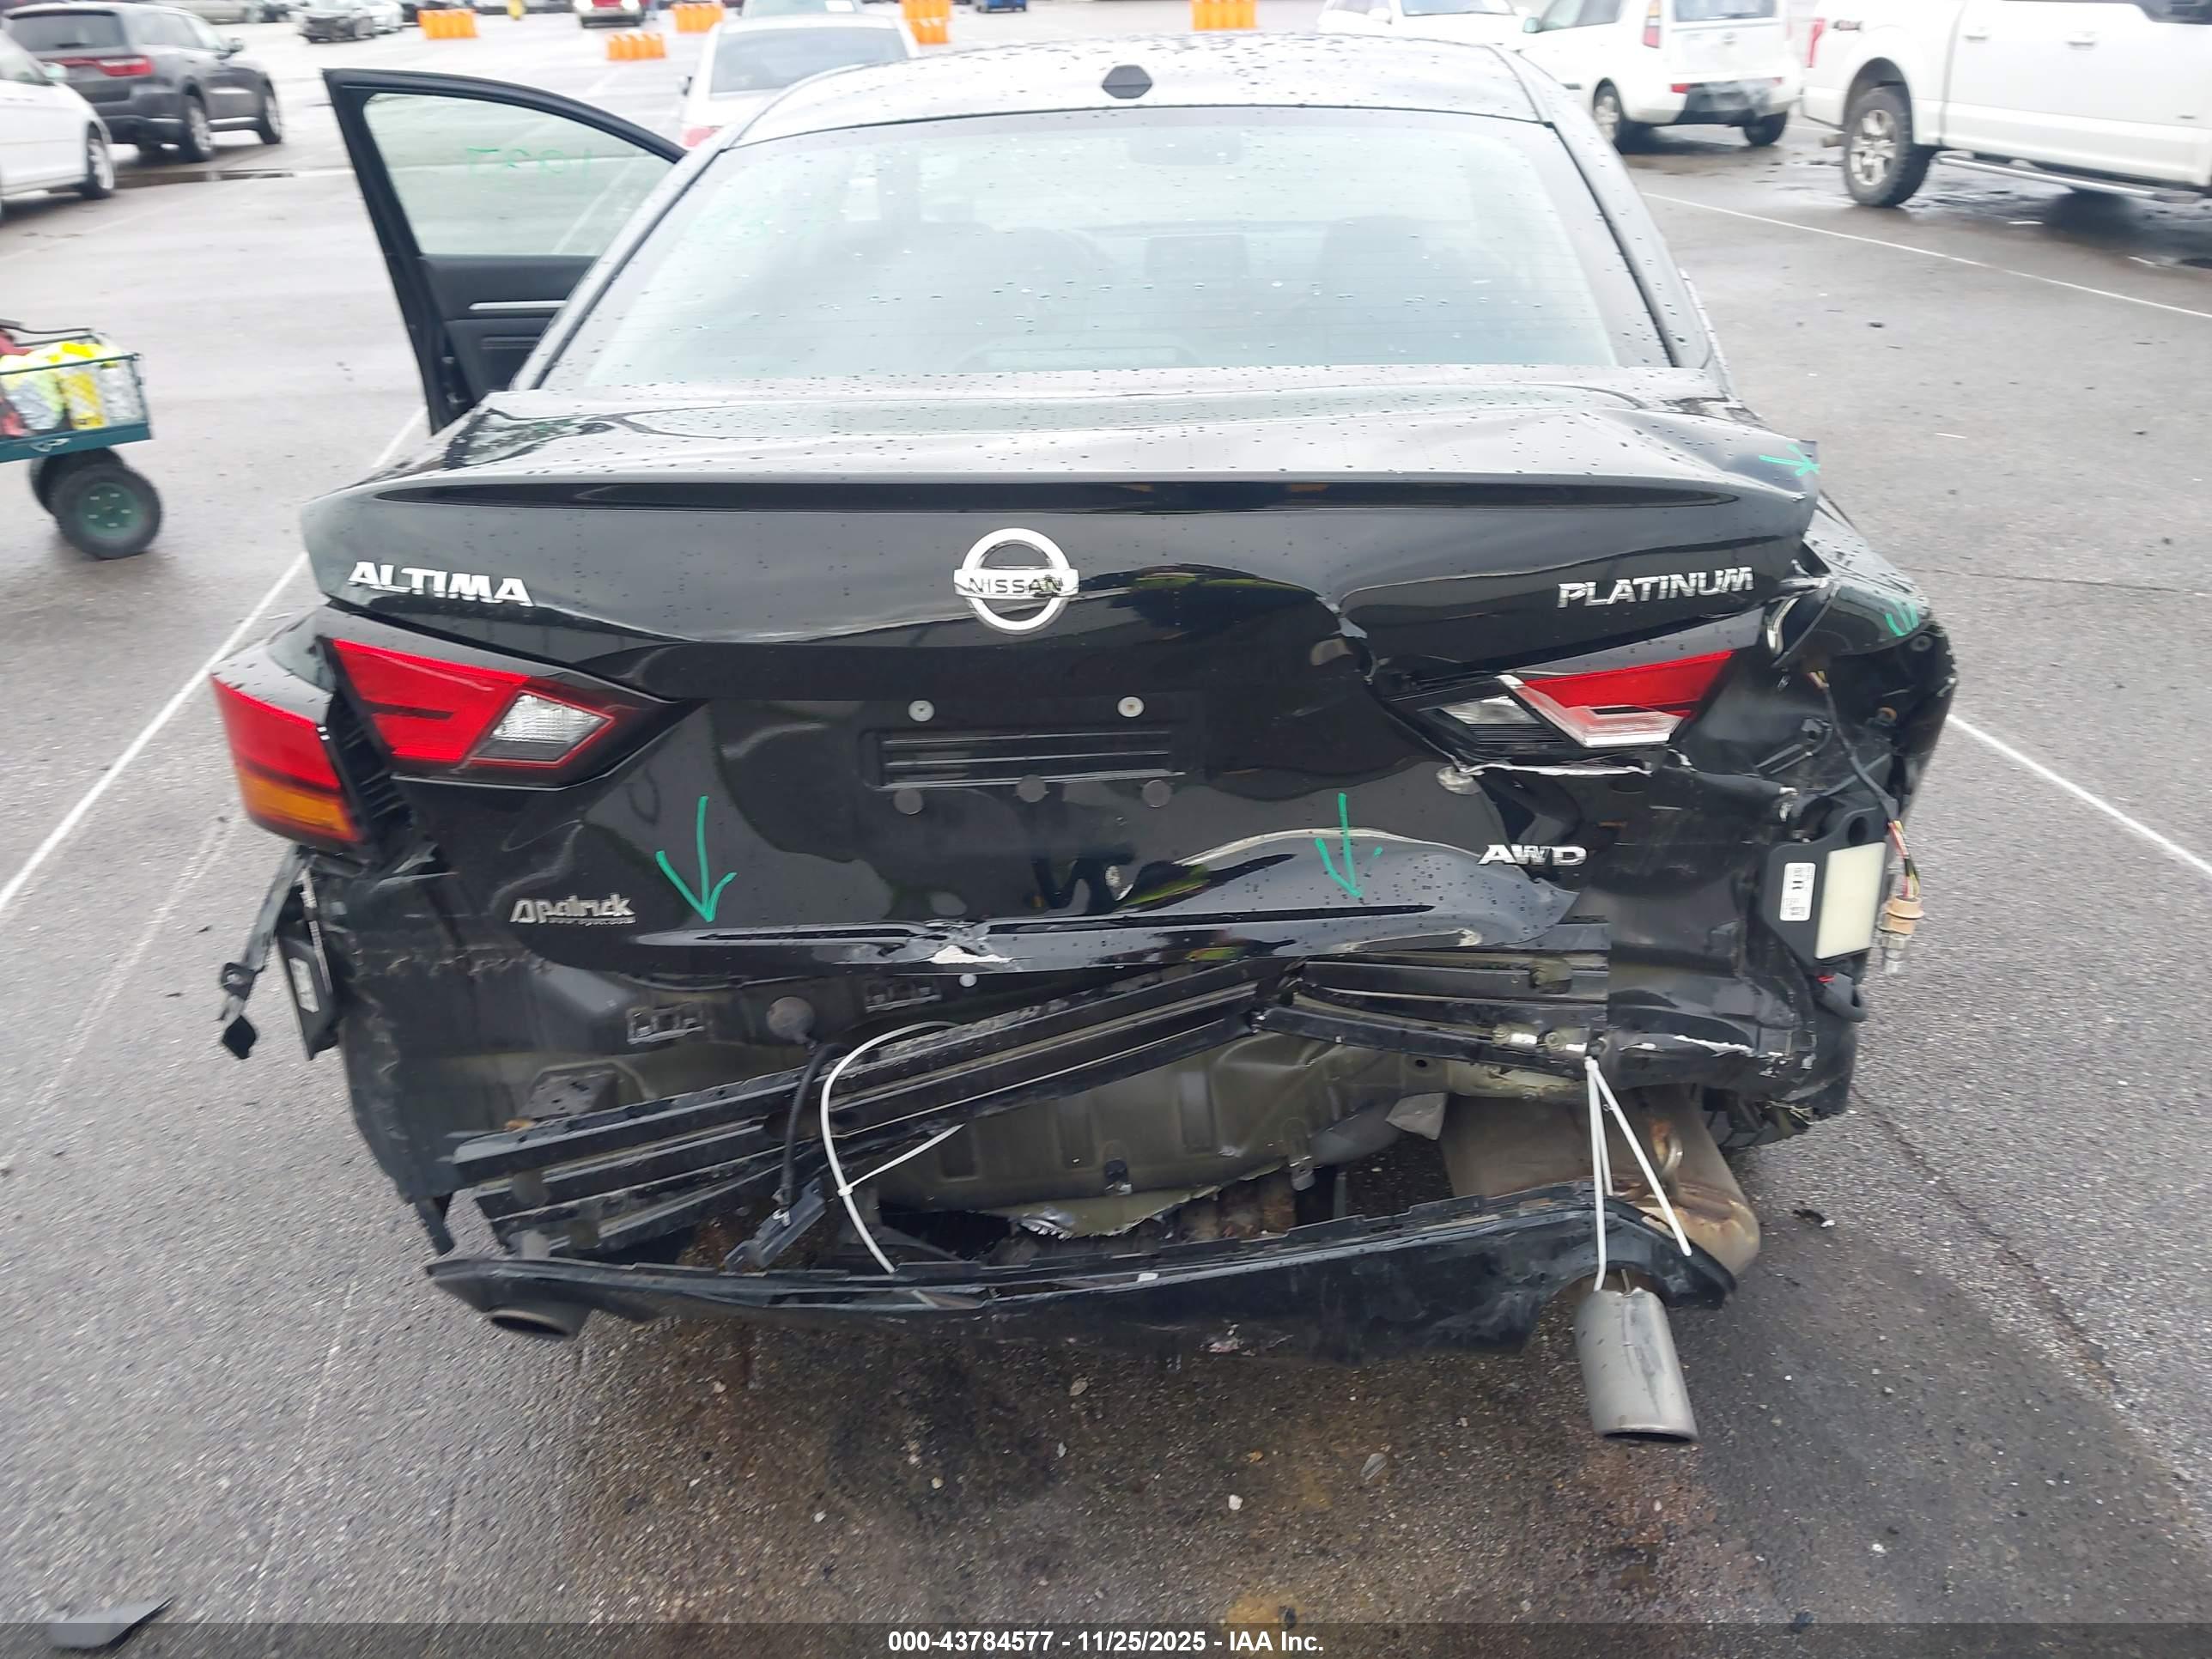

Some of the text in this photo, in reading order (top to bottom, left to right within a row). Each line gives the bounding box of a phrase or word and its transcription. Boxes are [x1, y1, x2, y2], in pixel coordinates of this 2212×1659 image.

[347, 561, 536, 607] ALTIMA
[969, 576, 1063, 594] NISSAN
[1556, 566, 1754, 609] PLATINUM
[1476, 843, 1588, 866] AWD
